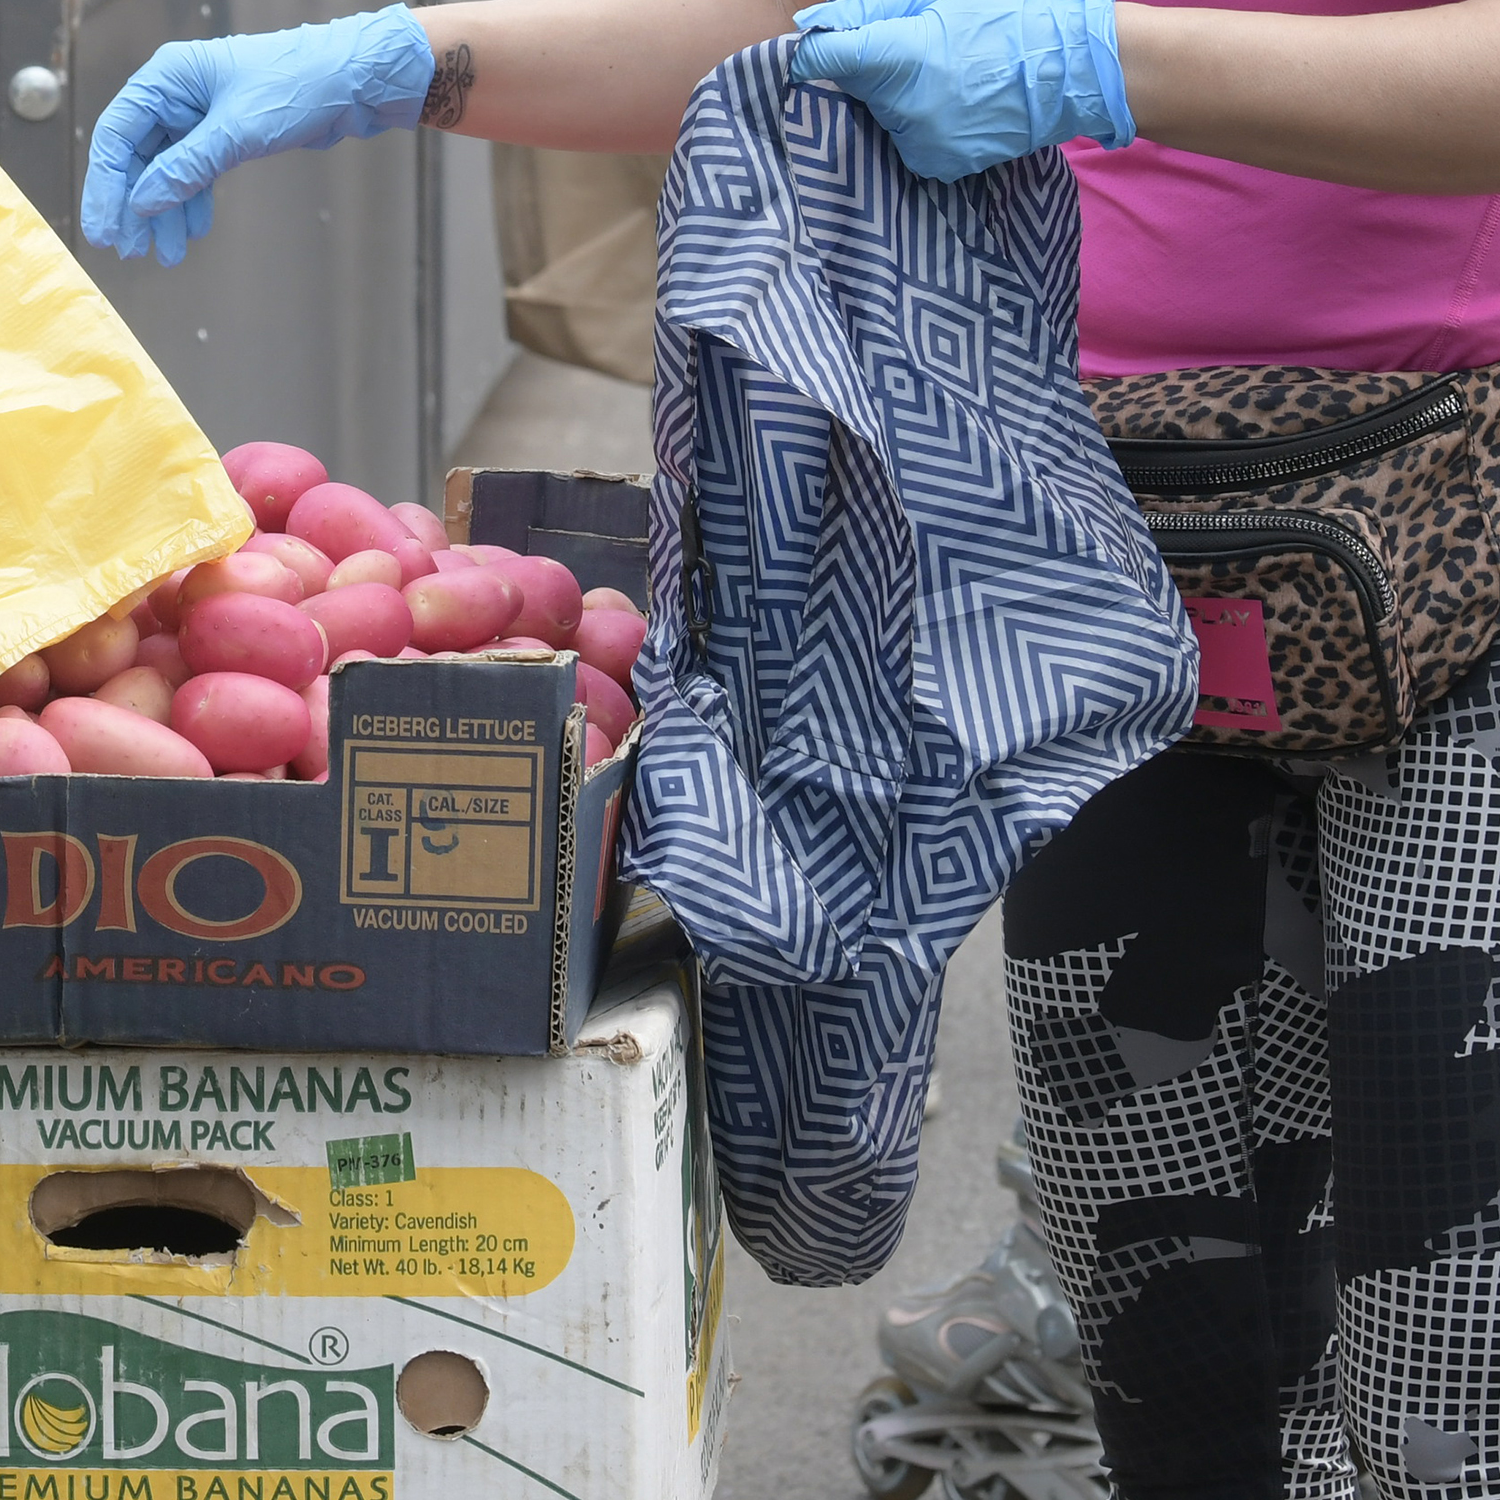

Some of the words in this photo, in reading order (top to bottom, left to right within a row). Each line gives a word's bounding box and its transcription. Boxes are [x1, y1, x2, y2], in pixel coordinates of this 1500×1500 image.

[352, 714, 440, 738] ICEBERG
[446, 717, 536, 741] LETTUCE
[367, 792, 395, 807] CAT.
[427, 795, 510, 815] CAL./SIZE
[358, 808, 403, 823] CLASS
[359, 827, 400, 882] I
[352, 908, 438, 931] VACUUM
[444, 911, 529, 935] COOLED
[37, 952, 368, 990] AMERICANO
[158, 1065, 414, 1115] BANANAS
[36, 1118, 182, 1151] VACUUM
[190, 1119, 276, 1152] PACK
[329, 1190, 379, 1207] Class:
[385, 1190, 394, 1207] 1
[329, 1212, 389, 1233] Variety:
[395, 1212, 478, 1230] Cavendish
[329, 1235, 401, 1253] Minimum
[409, 1235, 469, 1256] Length:
[475, 1234, 498, 1252] 20
[503, 1237, 529, 1252] cm
[329, 1258, 359, 1275] Net
[363, 1258, 389, 1276] Wt.
[395, 1257, 418, 1275] 40
[423, 1258, 443, 1275] lb.
[458, 1257, 508, 1278] 18,14
[513, 1257, 536, 1278] Kg
[176, 1474, 389, 1500] BANANAS
